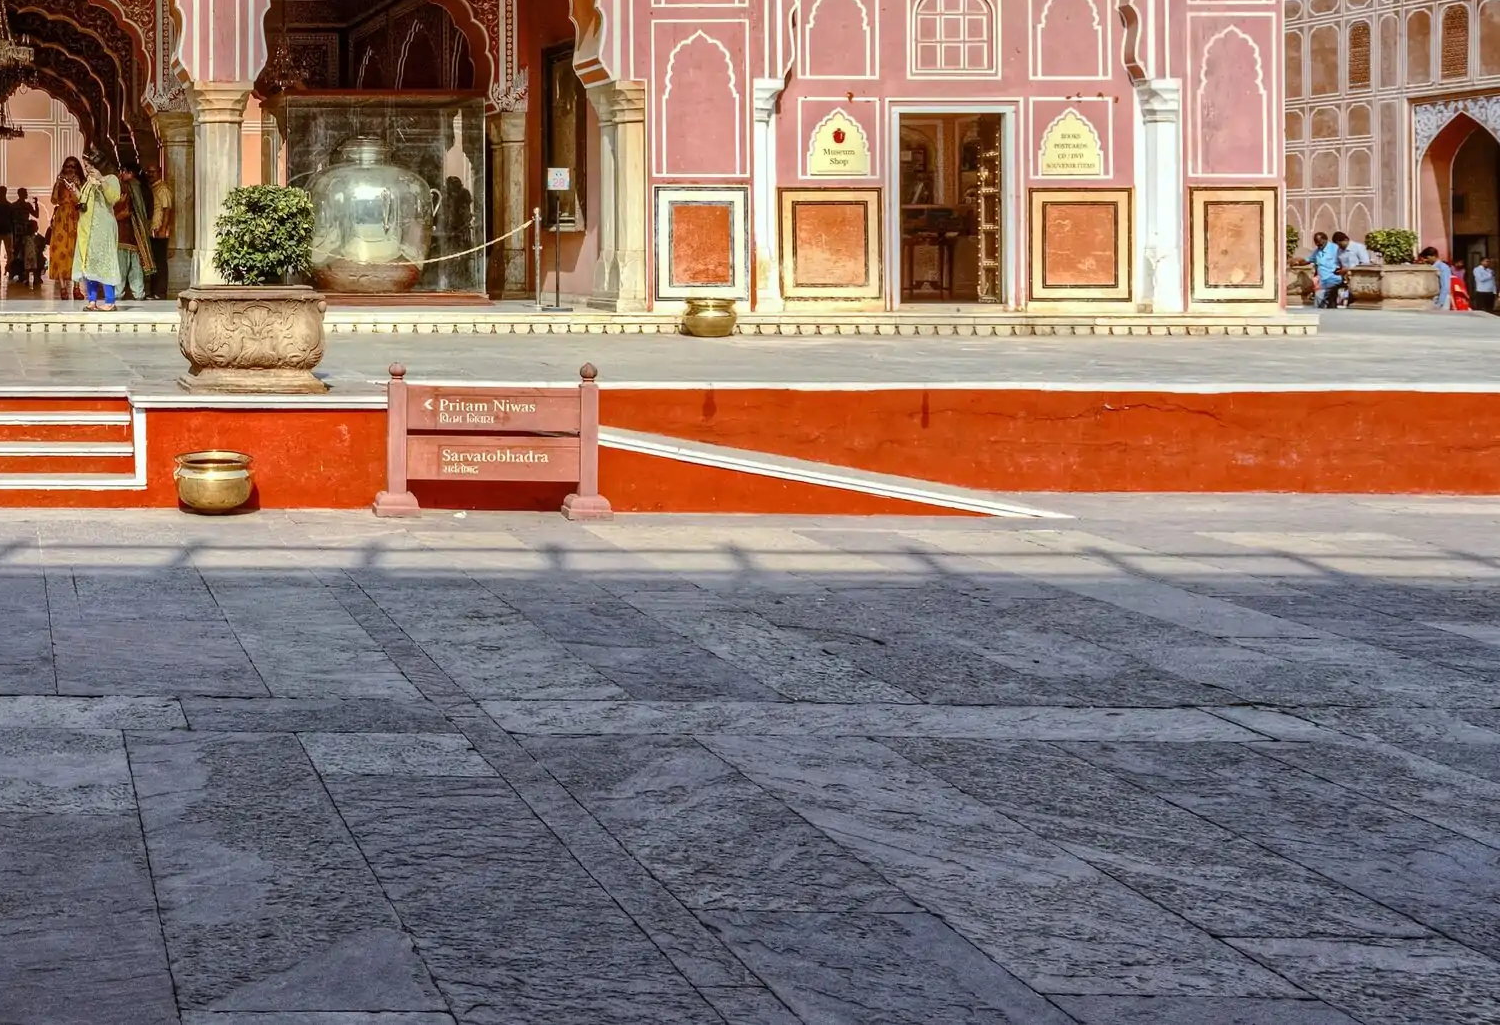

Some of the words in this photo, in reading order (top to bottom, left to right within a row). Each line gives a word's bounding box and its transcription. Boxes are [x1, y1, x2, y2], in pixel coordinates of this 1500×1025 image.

[823, 148, 855, 156] Museum
[829, 158, 849, 166] Shop
[439, 399, 488, 412] Pritam
[493, 399, 536, 413] Niwas
[442, 449, 549, 463] Sarvatobhadra
